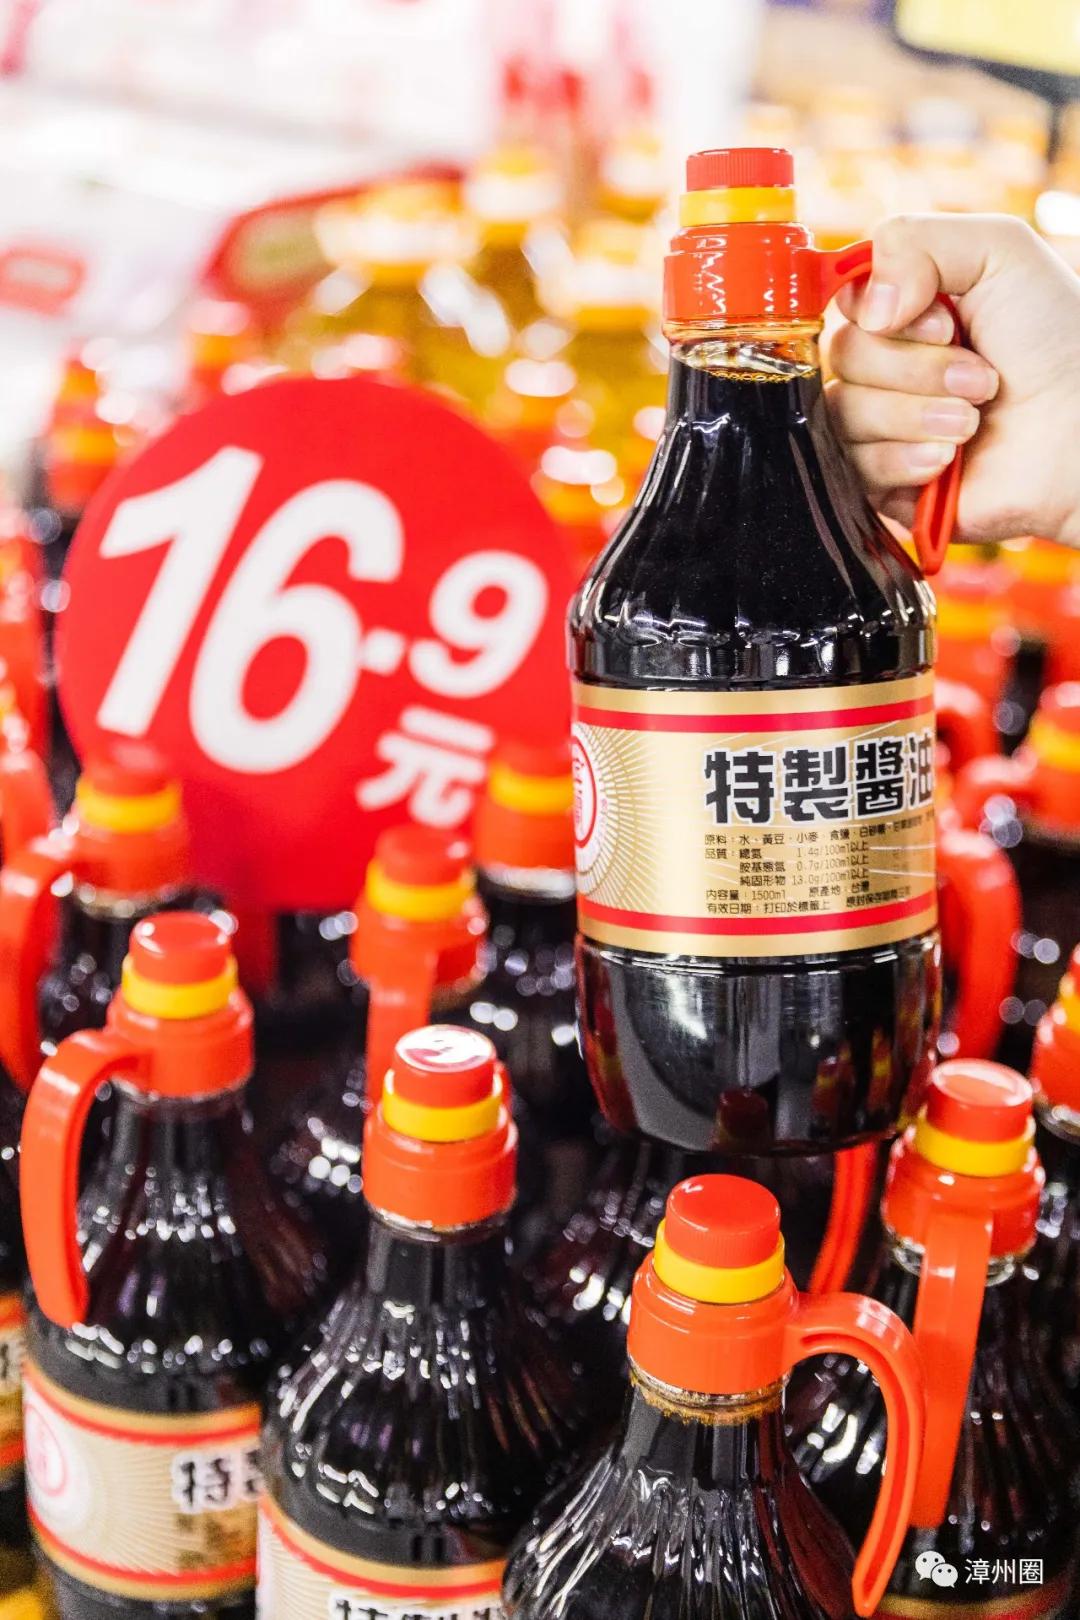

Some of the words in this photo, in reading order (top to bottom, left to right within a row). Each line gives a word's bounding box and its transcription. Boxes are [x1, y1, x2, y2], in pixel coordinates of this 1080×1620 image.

[98, 446, 549, 774] 16.9
[355, 705, 495, 829] 元
[704, 732, 932, 823] 特製醬油
